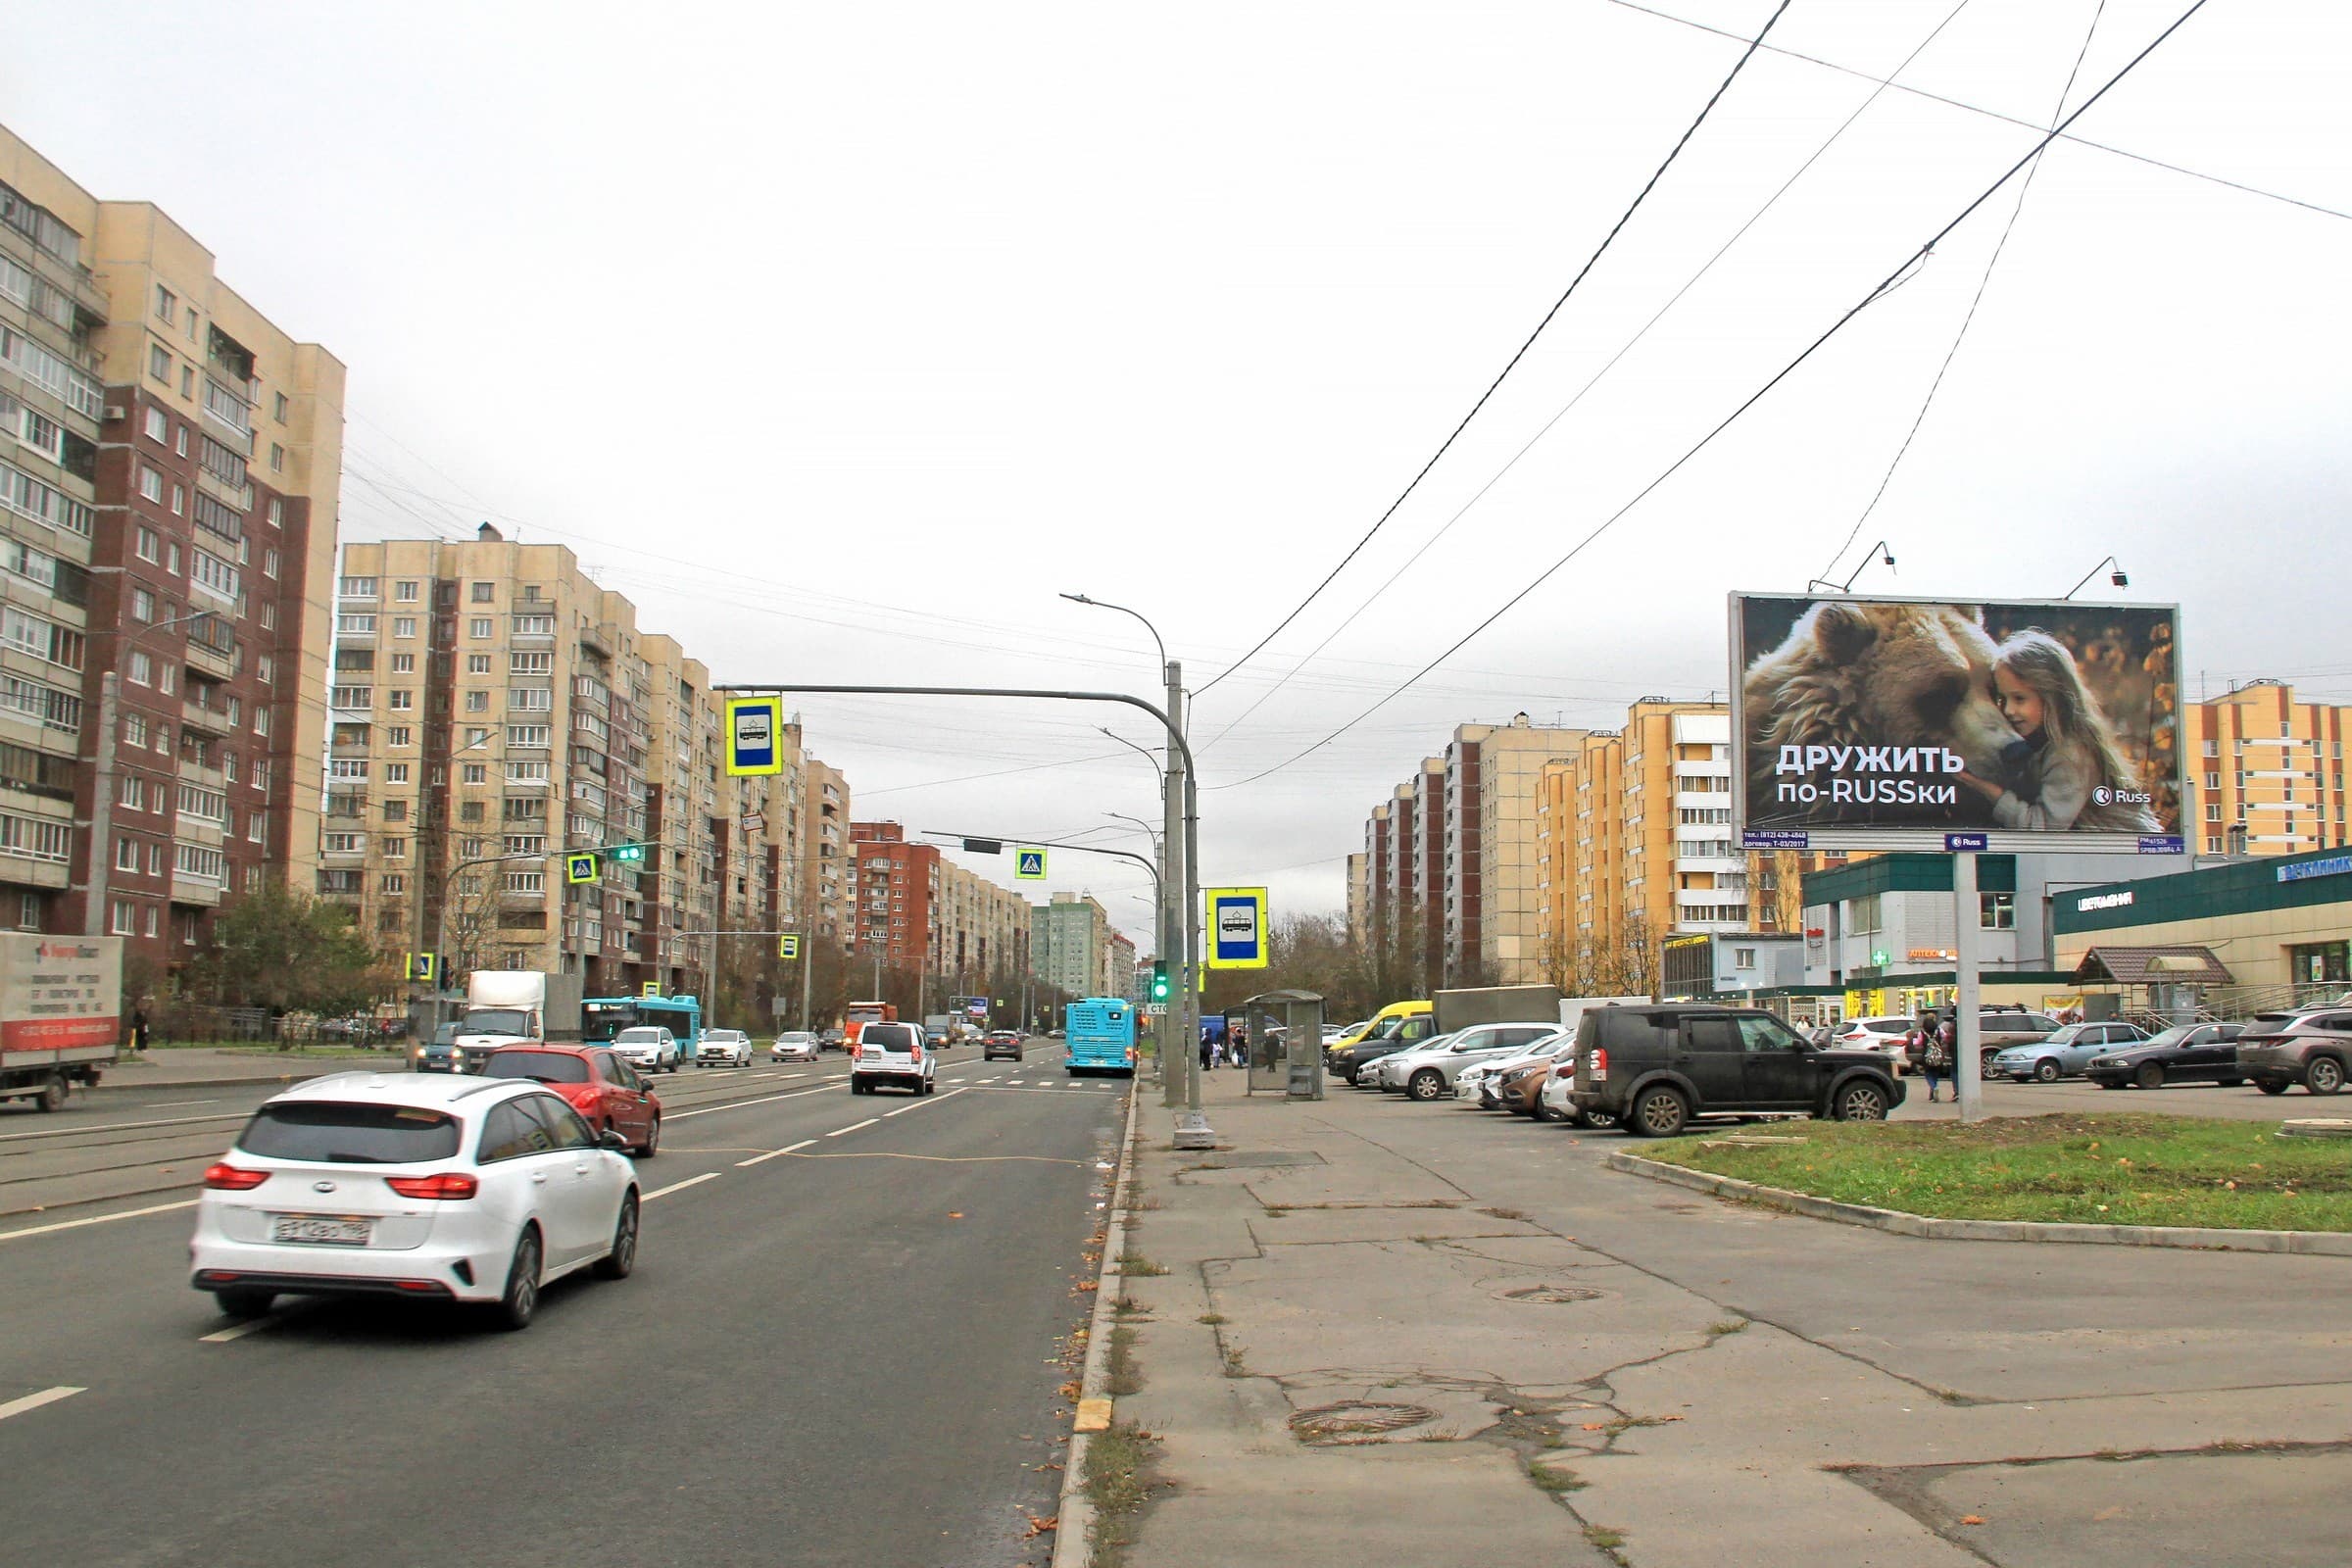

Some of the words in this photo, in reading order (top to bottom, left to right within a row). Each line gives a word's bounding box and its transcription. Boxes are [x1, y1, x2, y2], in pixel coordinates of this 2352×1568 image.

[1776, 745, 1965, 776] ДРУЖИТЬ
[1778, 778, 1956, 805] по-RUSSки
[2115, 790, 2152, 803] Russ
[1910, 949, 1939, 958] АПТЕКА
